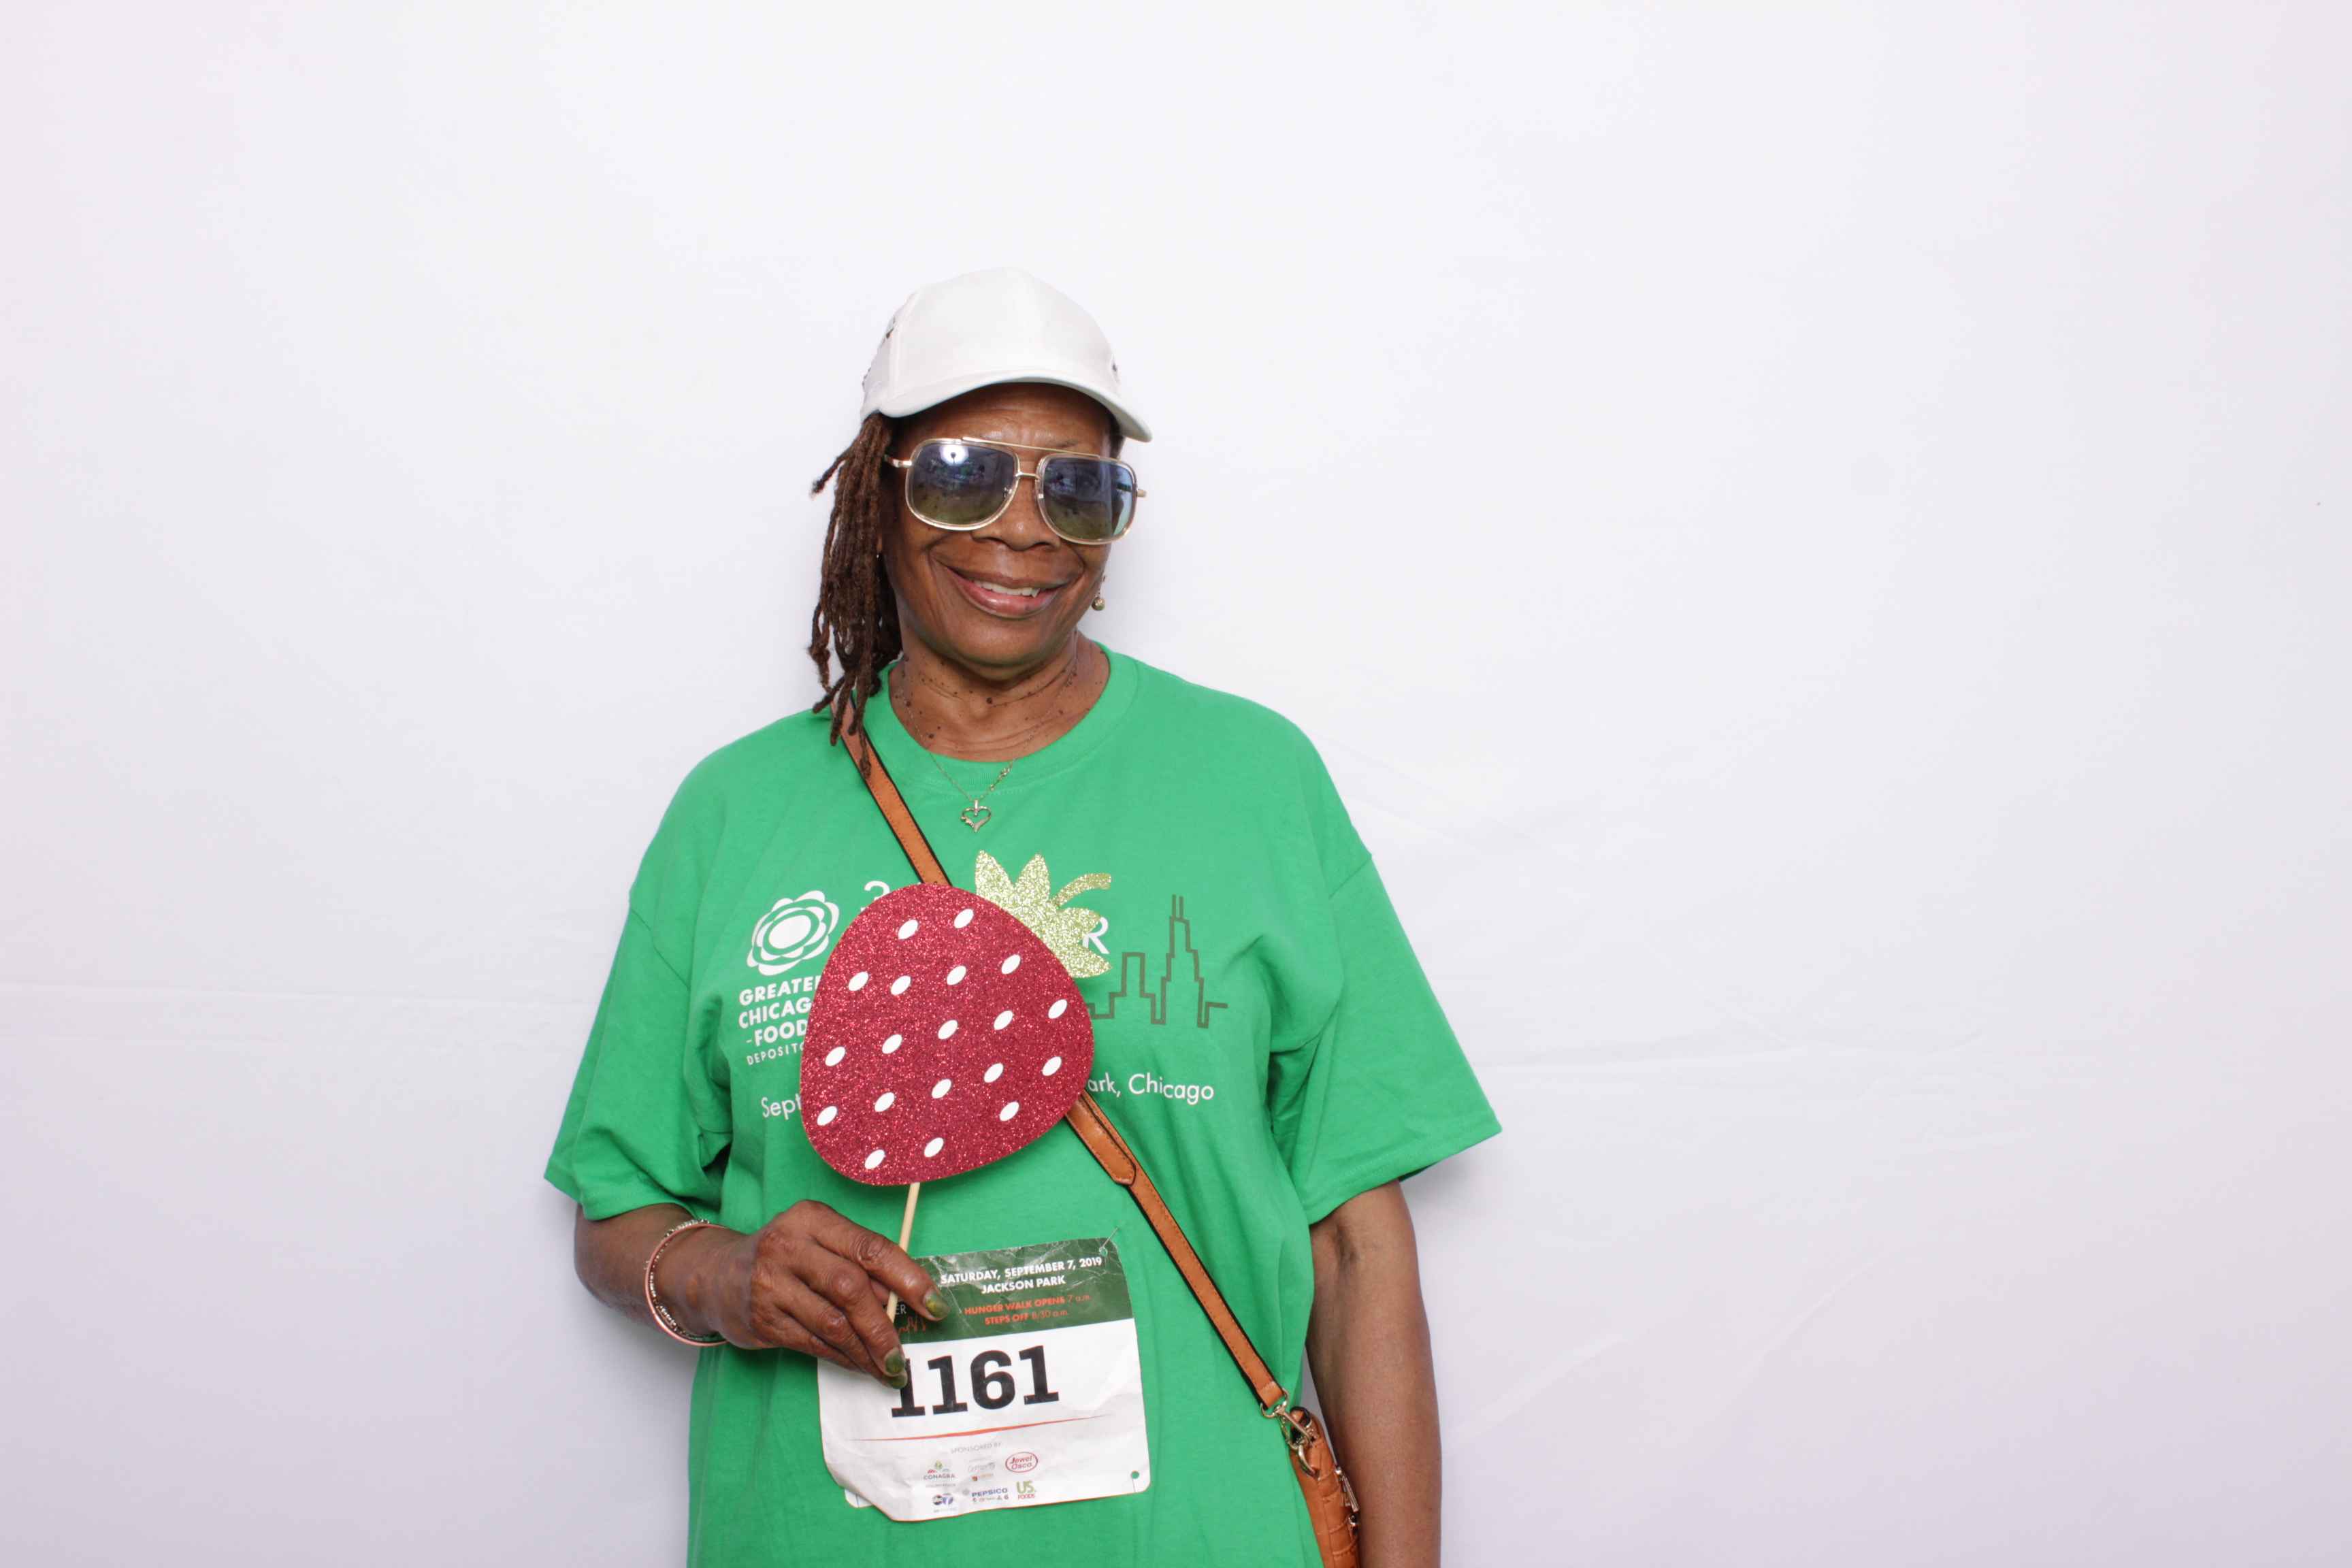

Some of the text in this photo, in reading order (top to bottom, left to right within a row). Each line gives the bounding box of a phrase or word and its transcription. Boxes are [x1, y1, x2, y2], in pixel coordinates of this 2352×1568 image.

[738, 997, 812, 1029] CHICAG
[761, 1072, 1214, 1120] Sept ark, Chicago
[941, 1257, 1102, 1284] SATURDAY, SEPTEMBER 7, 2019
[981, 1275, 1066, 1294] JACKSON PARK
[964, 1303, 1004, 1315] HUNGER
[1005, 1301, 1033, 1310] WALK
[1034, 1296, 1065, 1307] OPENS
[985, 1314, 1011, 1325] STEPS
[1012, 1313, 1030, 1322] OFF
[1032, 1310, 1051, 1320] 8:30
[890, 1345, 1060, 1418] 1161
[950, 1443, 992, 1454] SPONSORED
[1009, 1455, 1032, 1464] Jewel
[972, 1488, 1008, 1497] PEPSICO
